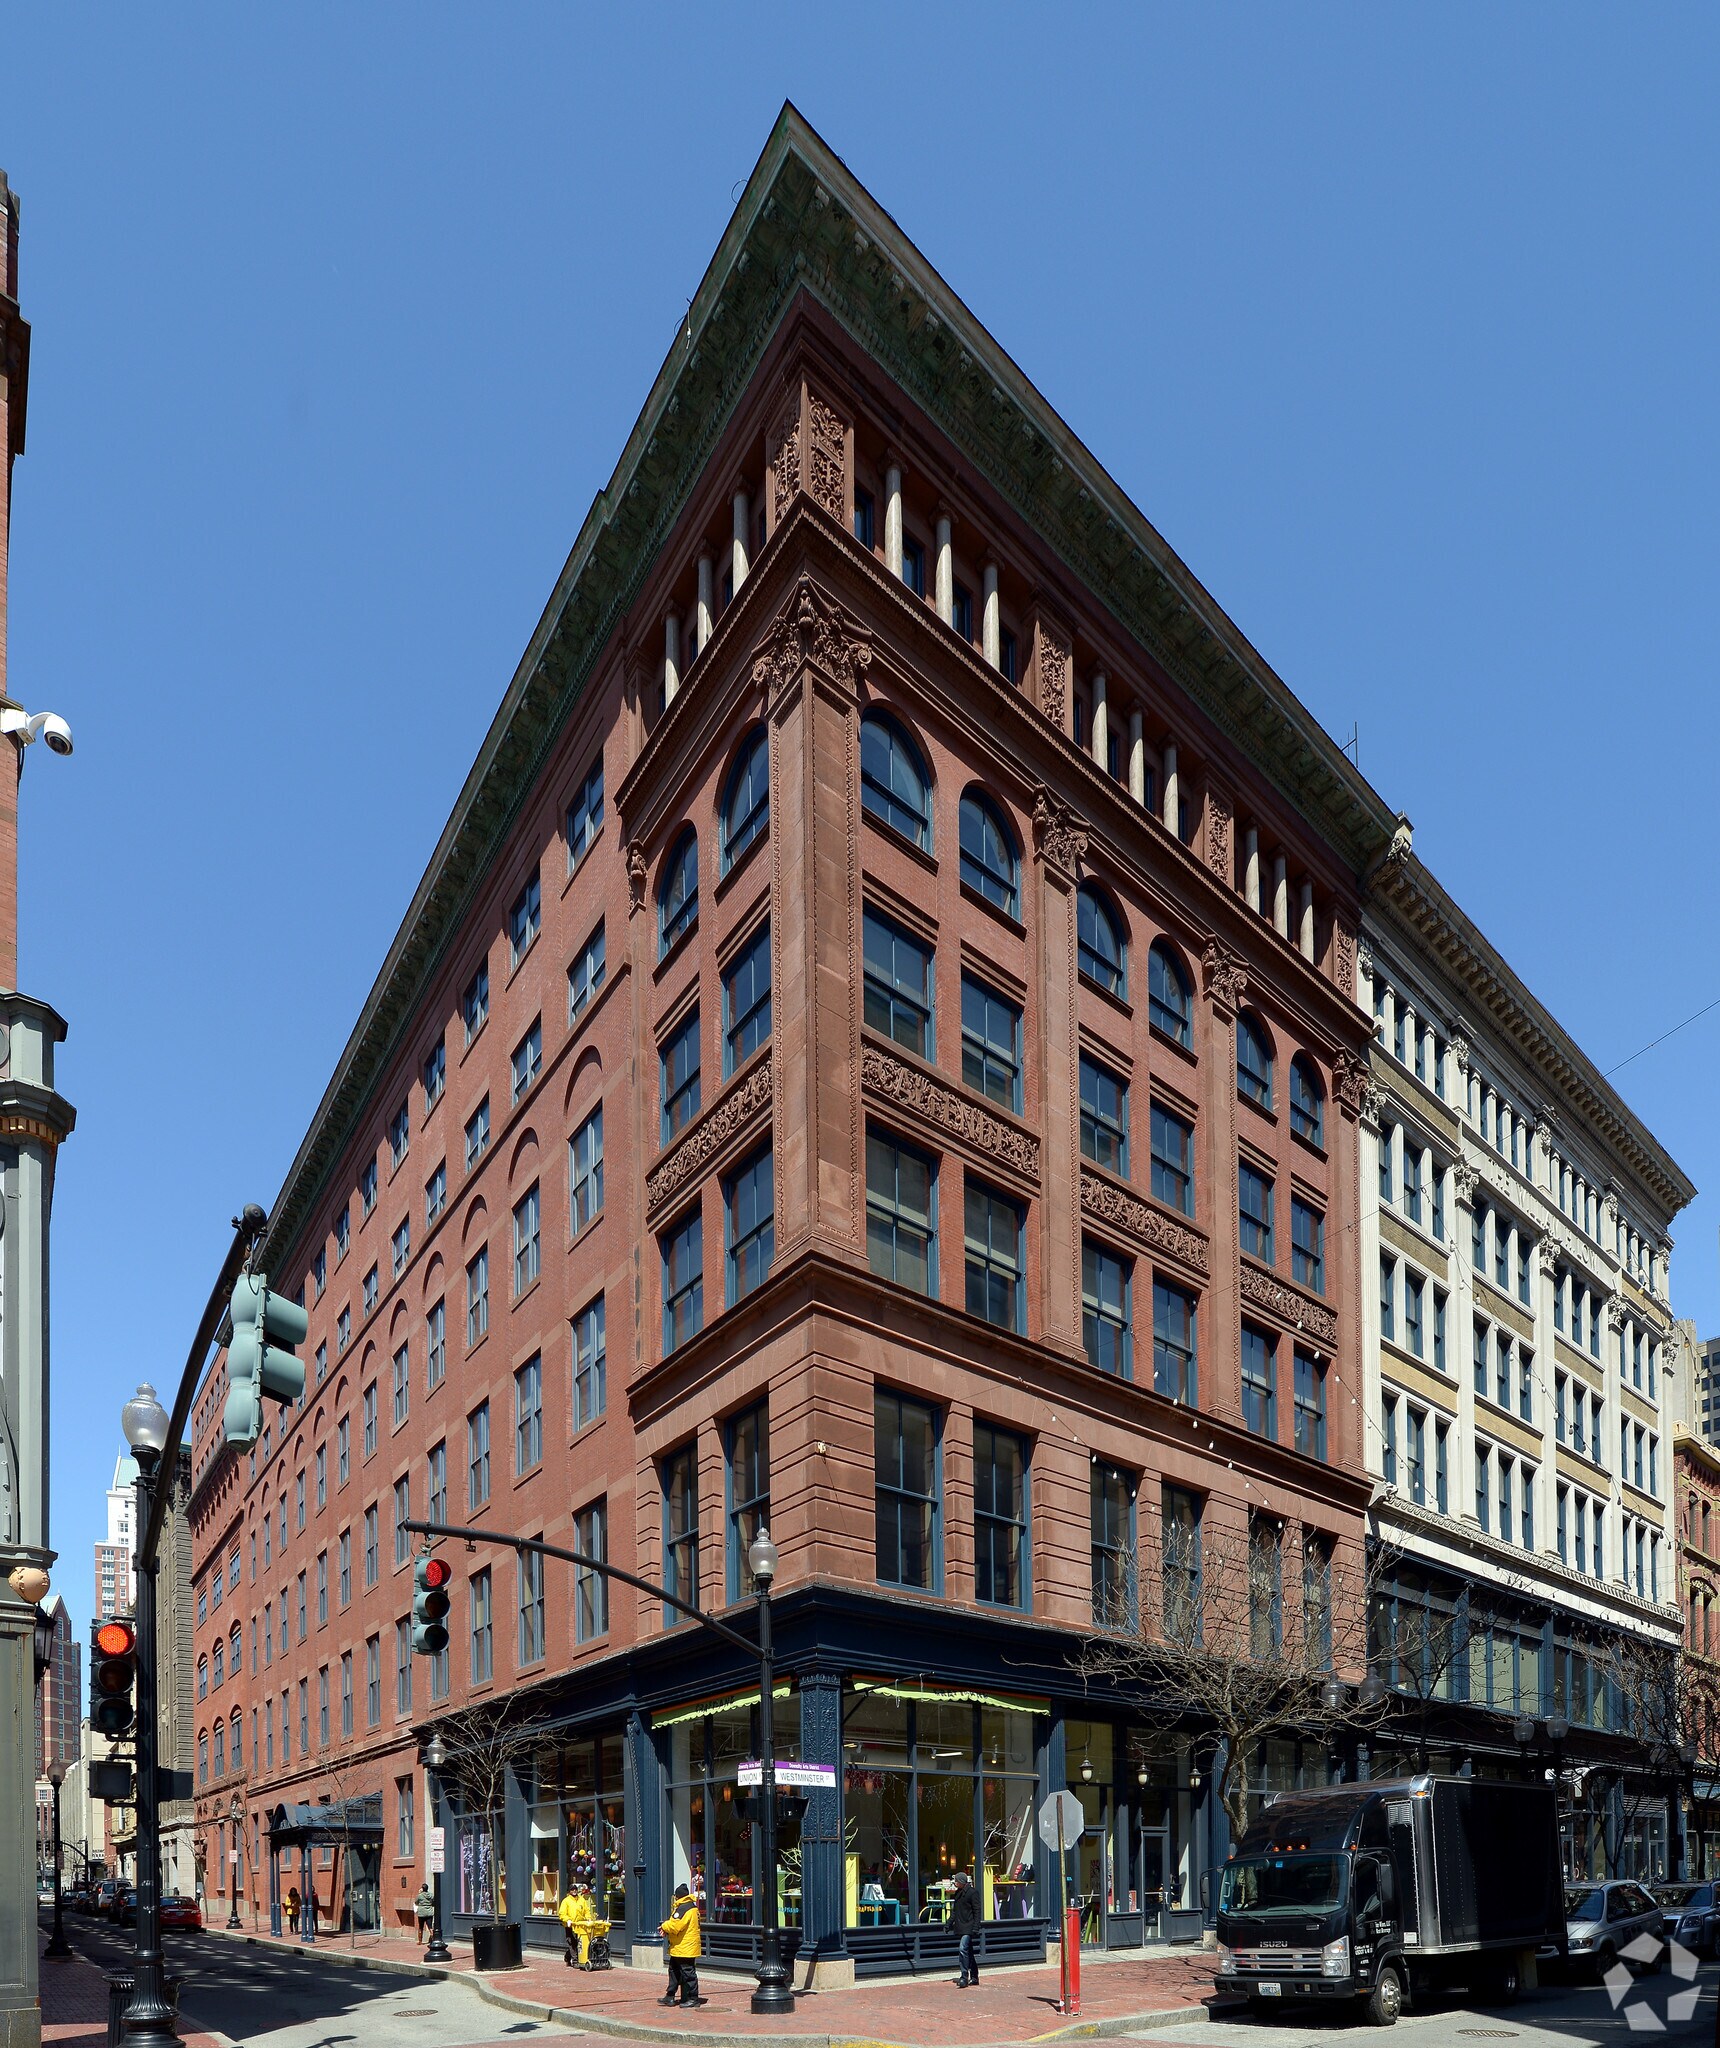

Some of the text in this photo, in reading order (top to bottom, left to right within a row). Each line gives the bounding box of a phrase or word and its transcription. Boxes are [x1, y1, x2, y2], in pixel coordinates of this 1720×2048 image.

[739, 1773, 758, 1783] UNION
[780, 1772, 825, 1784] WESTMINSTER
[855, 1905, 883, 1913] CRAFTLAND
[1259, 1940, 1288, 1948] ISUZU
